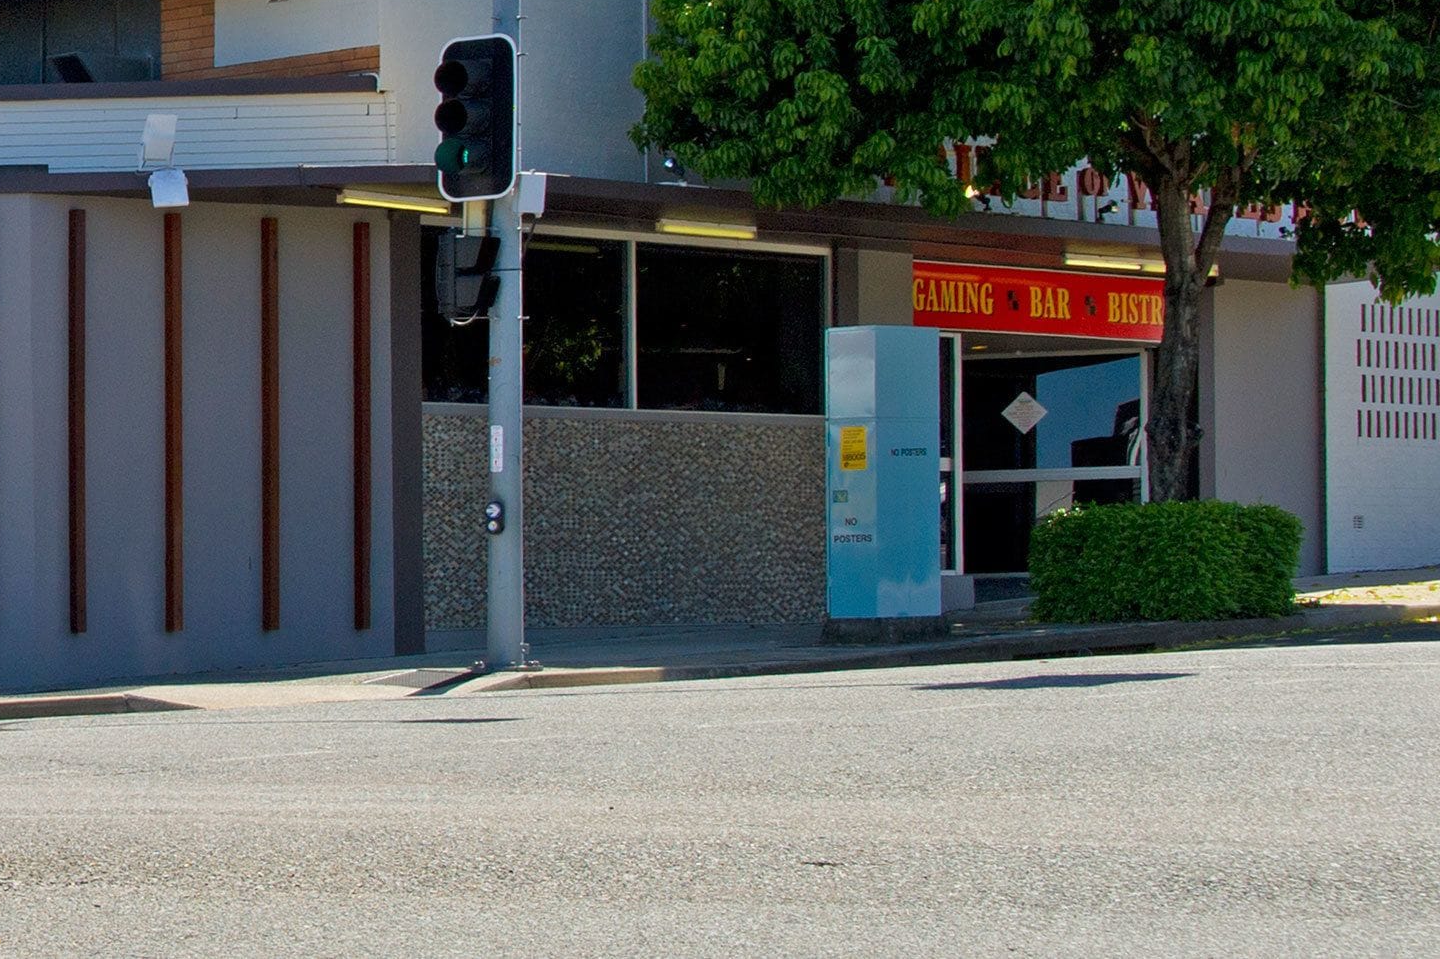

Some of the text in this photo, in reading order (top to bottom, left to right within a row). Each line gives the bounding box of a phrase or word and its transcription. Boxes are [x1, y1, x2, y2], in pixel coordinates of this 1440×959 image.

[912, 278, 1164, 326] GAMING BAR BISTR
[890, 447, 927, 457] NO POSTERS
[844, 517, 857, 526] NO
[833, 533, 872, 543] POSTERS
